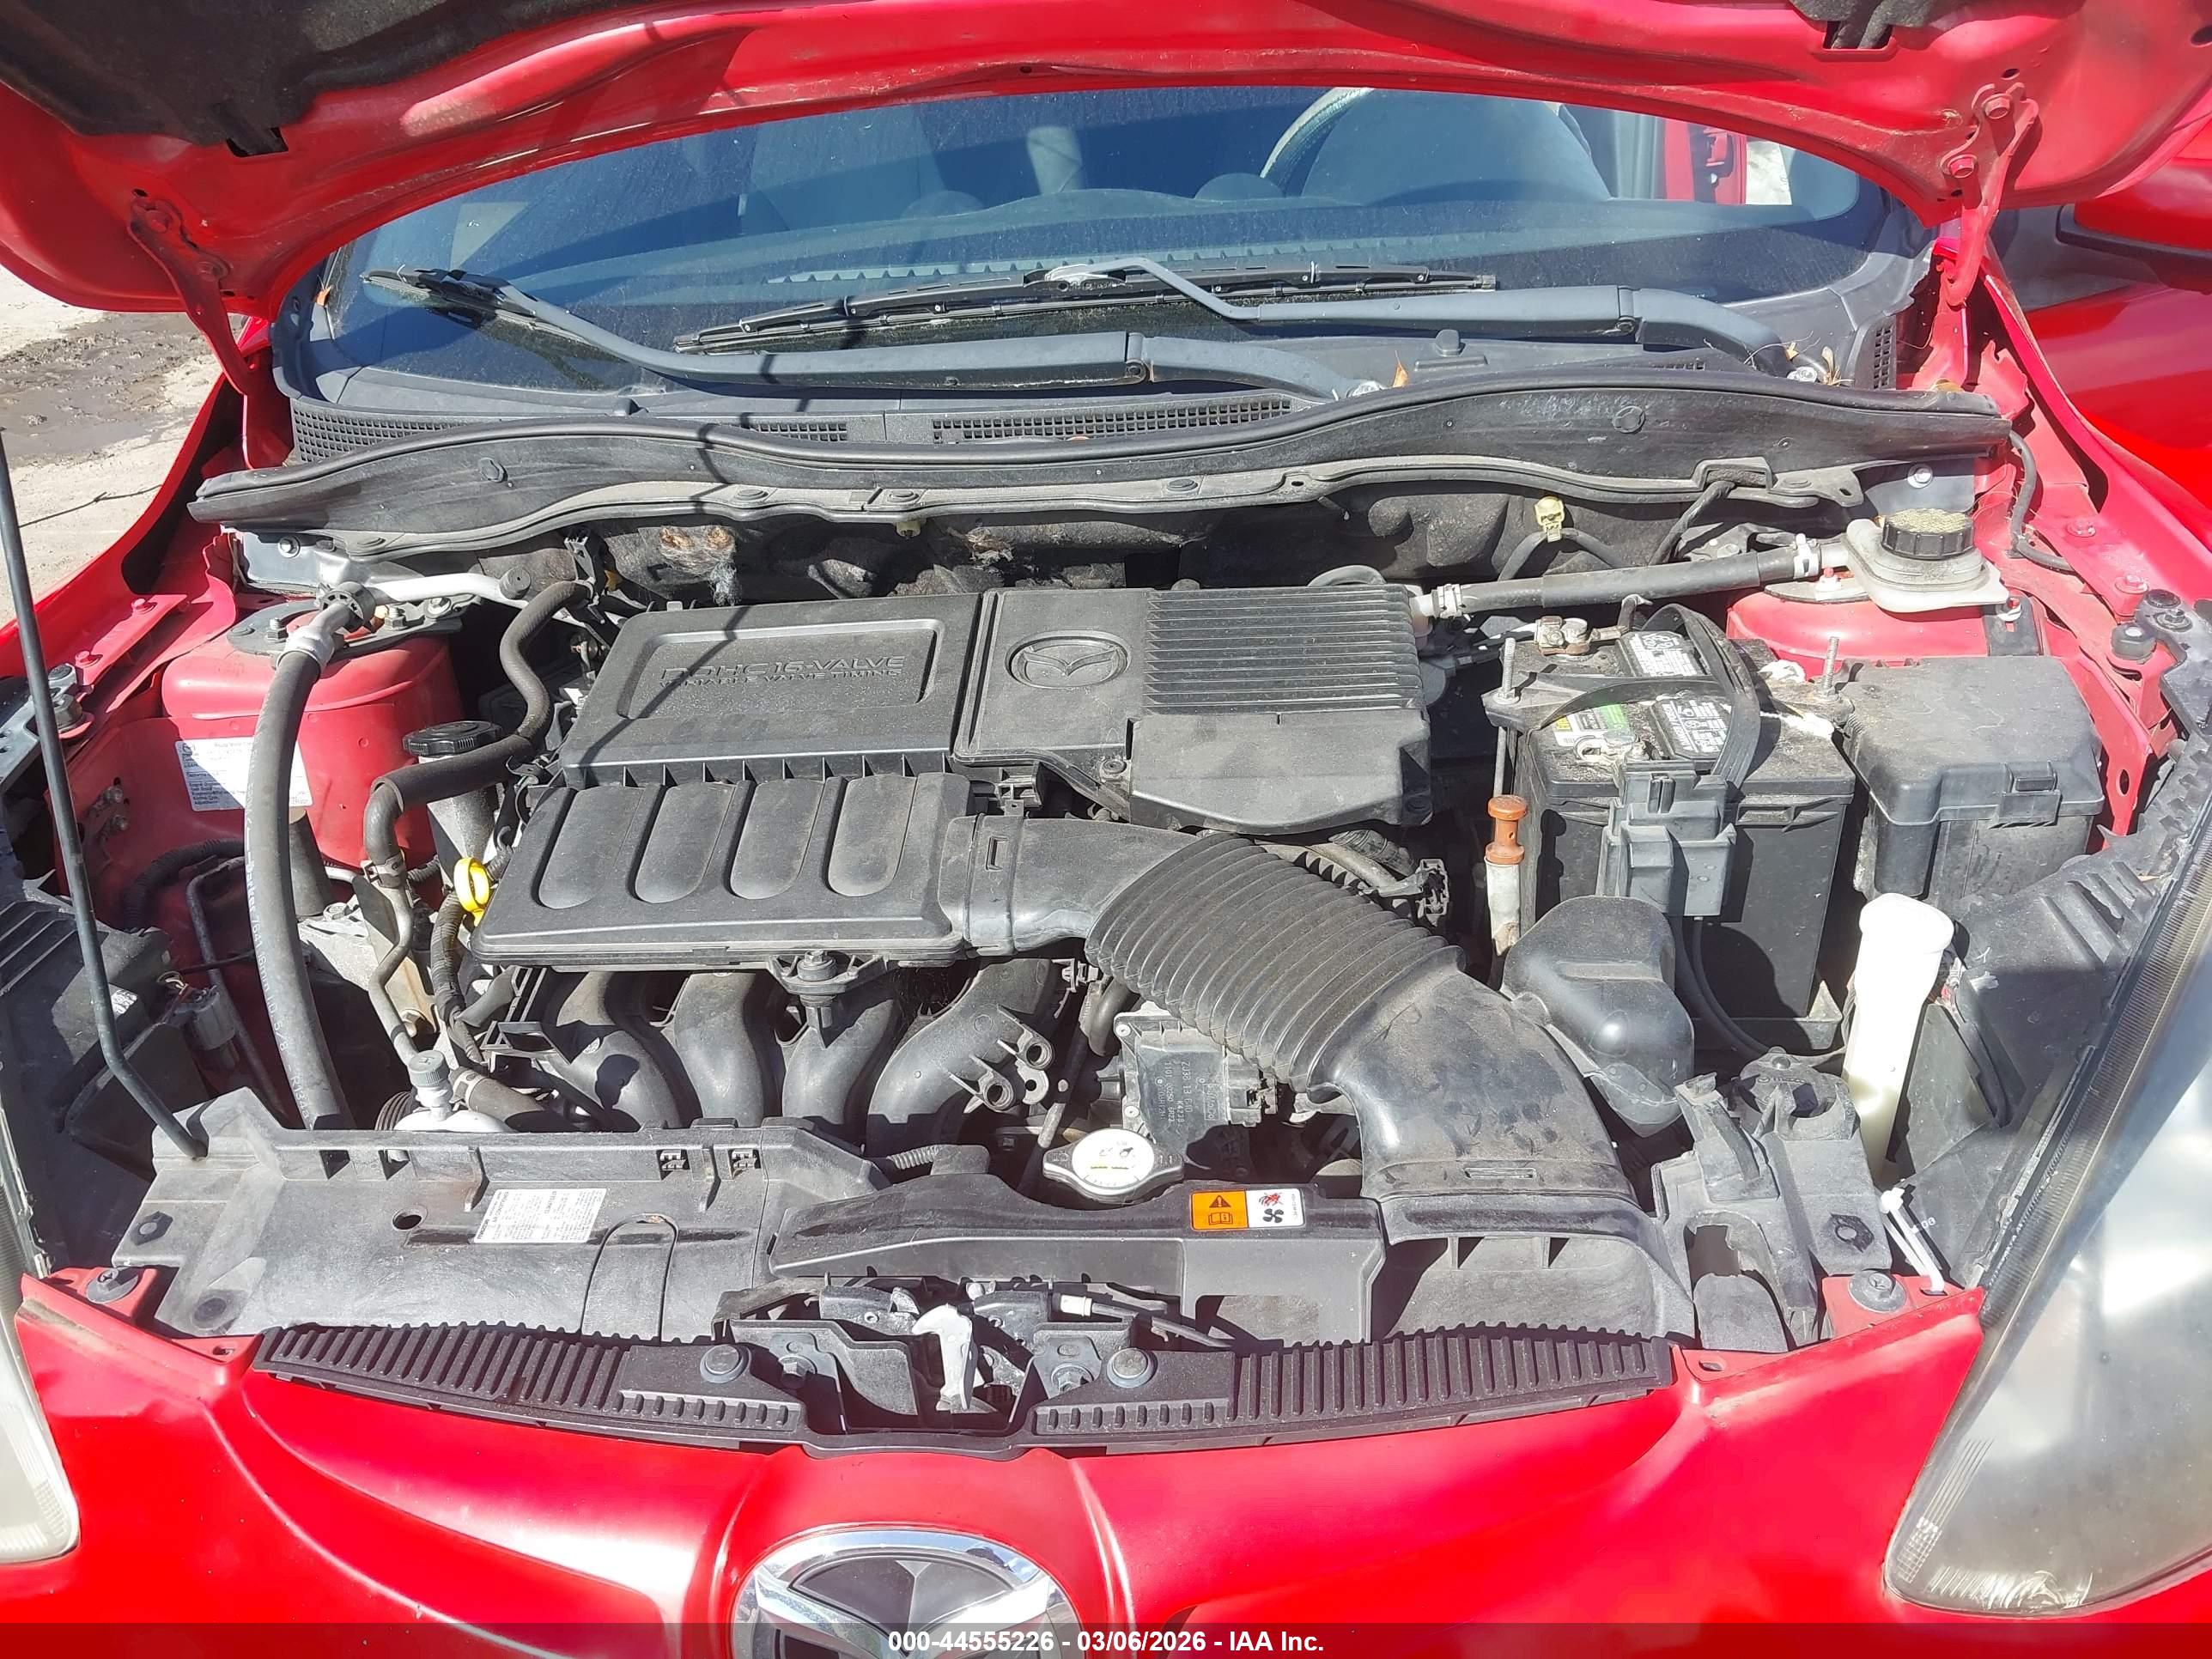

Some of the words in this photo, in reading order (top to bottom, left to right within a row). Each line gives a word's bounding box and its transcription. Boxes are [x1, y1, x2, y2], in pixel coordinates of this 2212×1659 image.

[662, 663, 769, 679] DOHC
[775, 656, 907, 673] 16-VALVE
[764, 672, 826, 683] VALVE
[830, 669, 902, 678] TIMING
[289, 1076, 312, 1120] R134a
